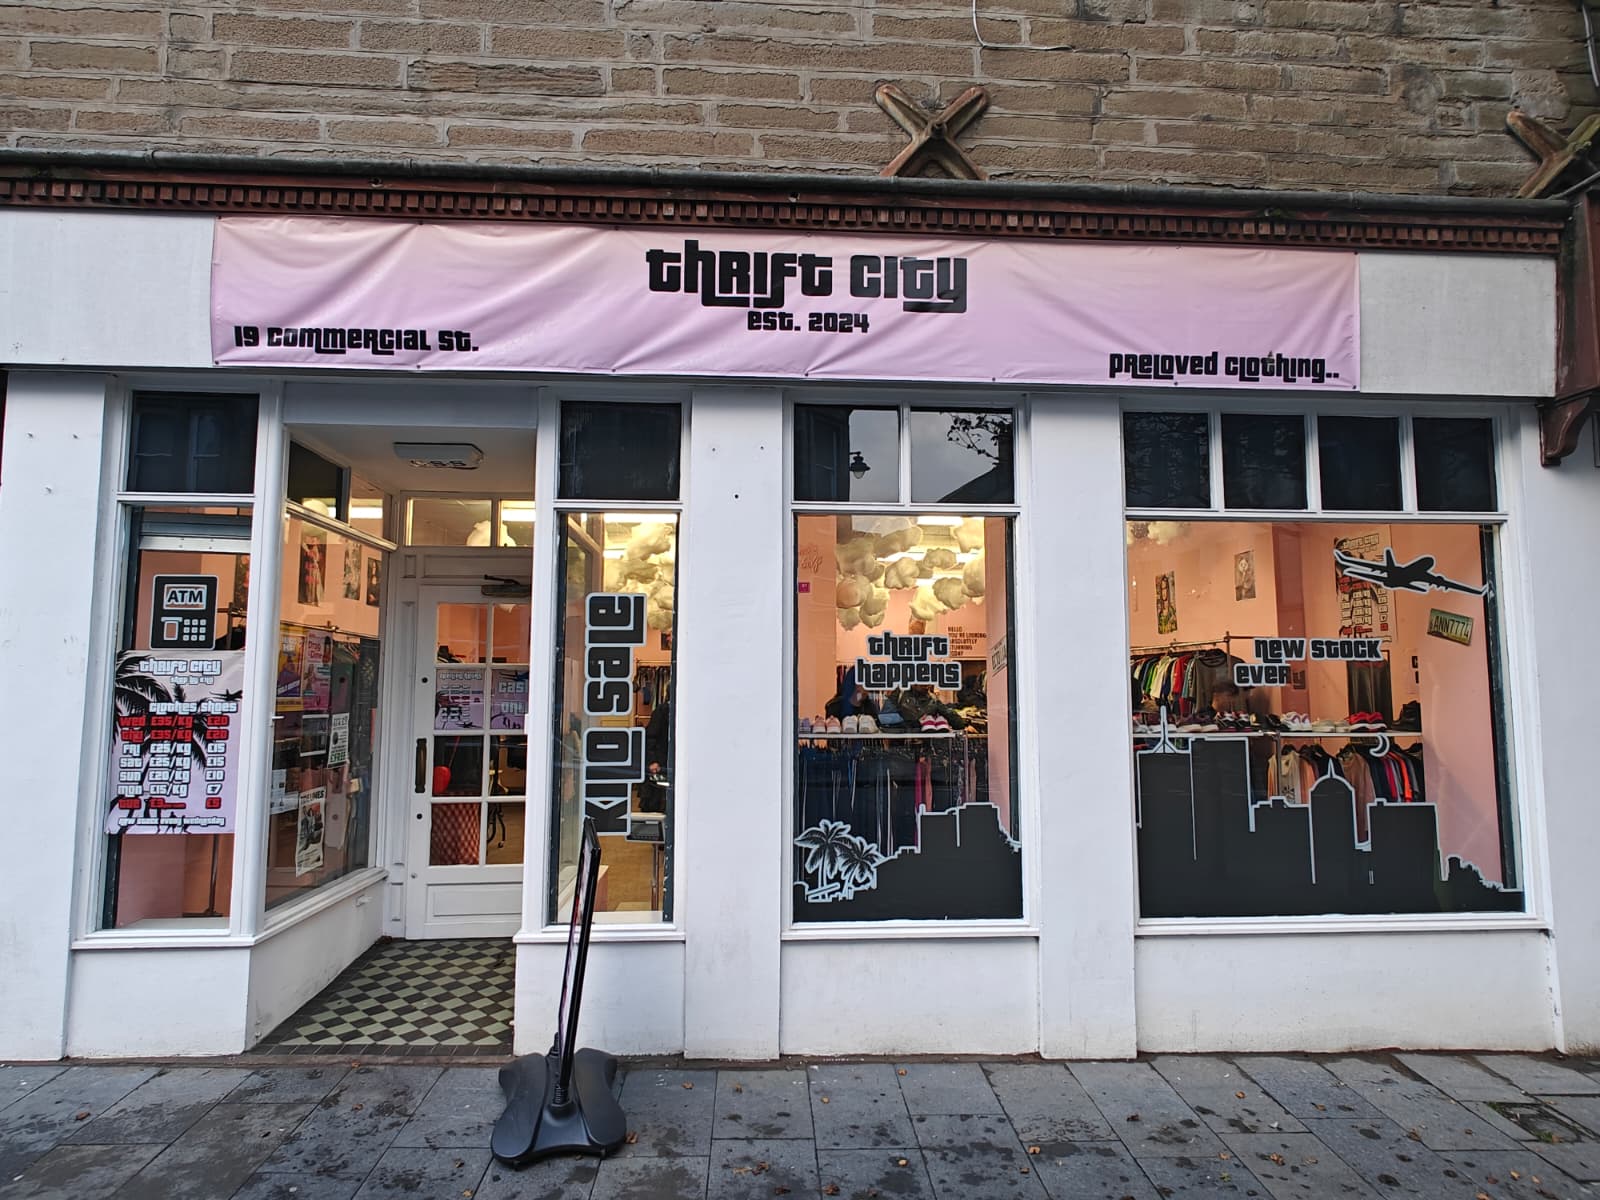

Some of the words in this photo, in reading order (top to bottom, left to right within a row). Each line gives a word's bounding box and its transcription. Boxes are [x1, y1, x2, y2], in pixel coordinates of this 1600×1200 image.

[747, 311, 801, 331] est.
[808, 313, 869, 333] 2024
[234, 325, 259, 347] 19
[267, 327, 431, 355] commercial
[438, 330, 479, 351] st.
[1109, 351, 1218, 380] preloved
[167, 590, 203, 603] ATM
[1254, 639, 1305, 663] new
[1311, 639, 1382, 659] stock
[857, 659, 960, 688] happens
[149, 700, 198, 715] clothes
[200, 700, 238, 715] shoes
